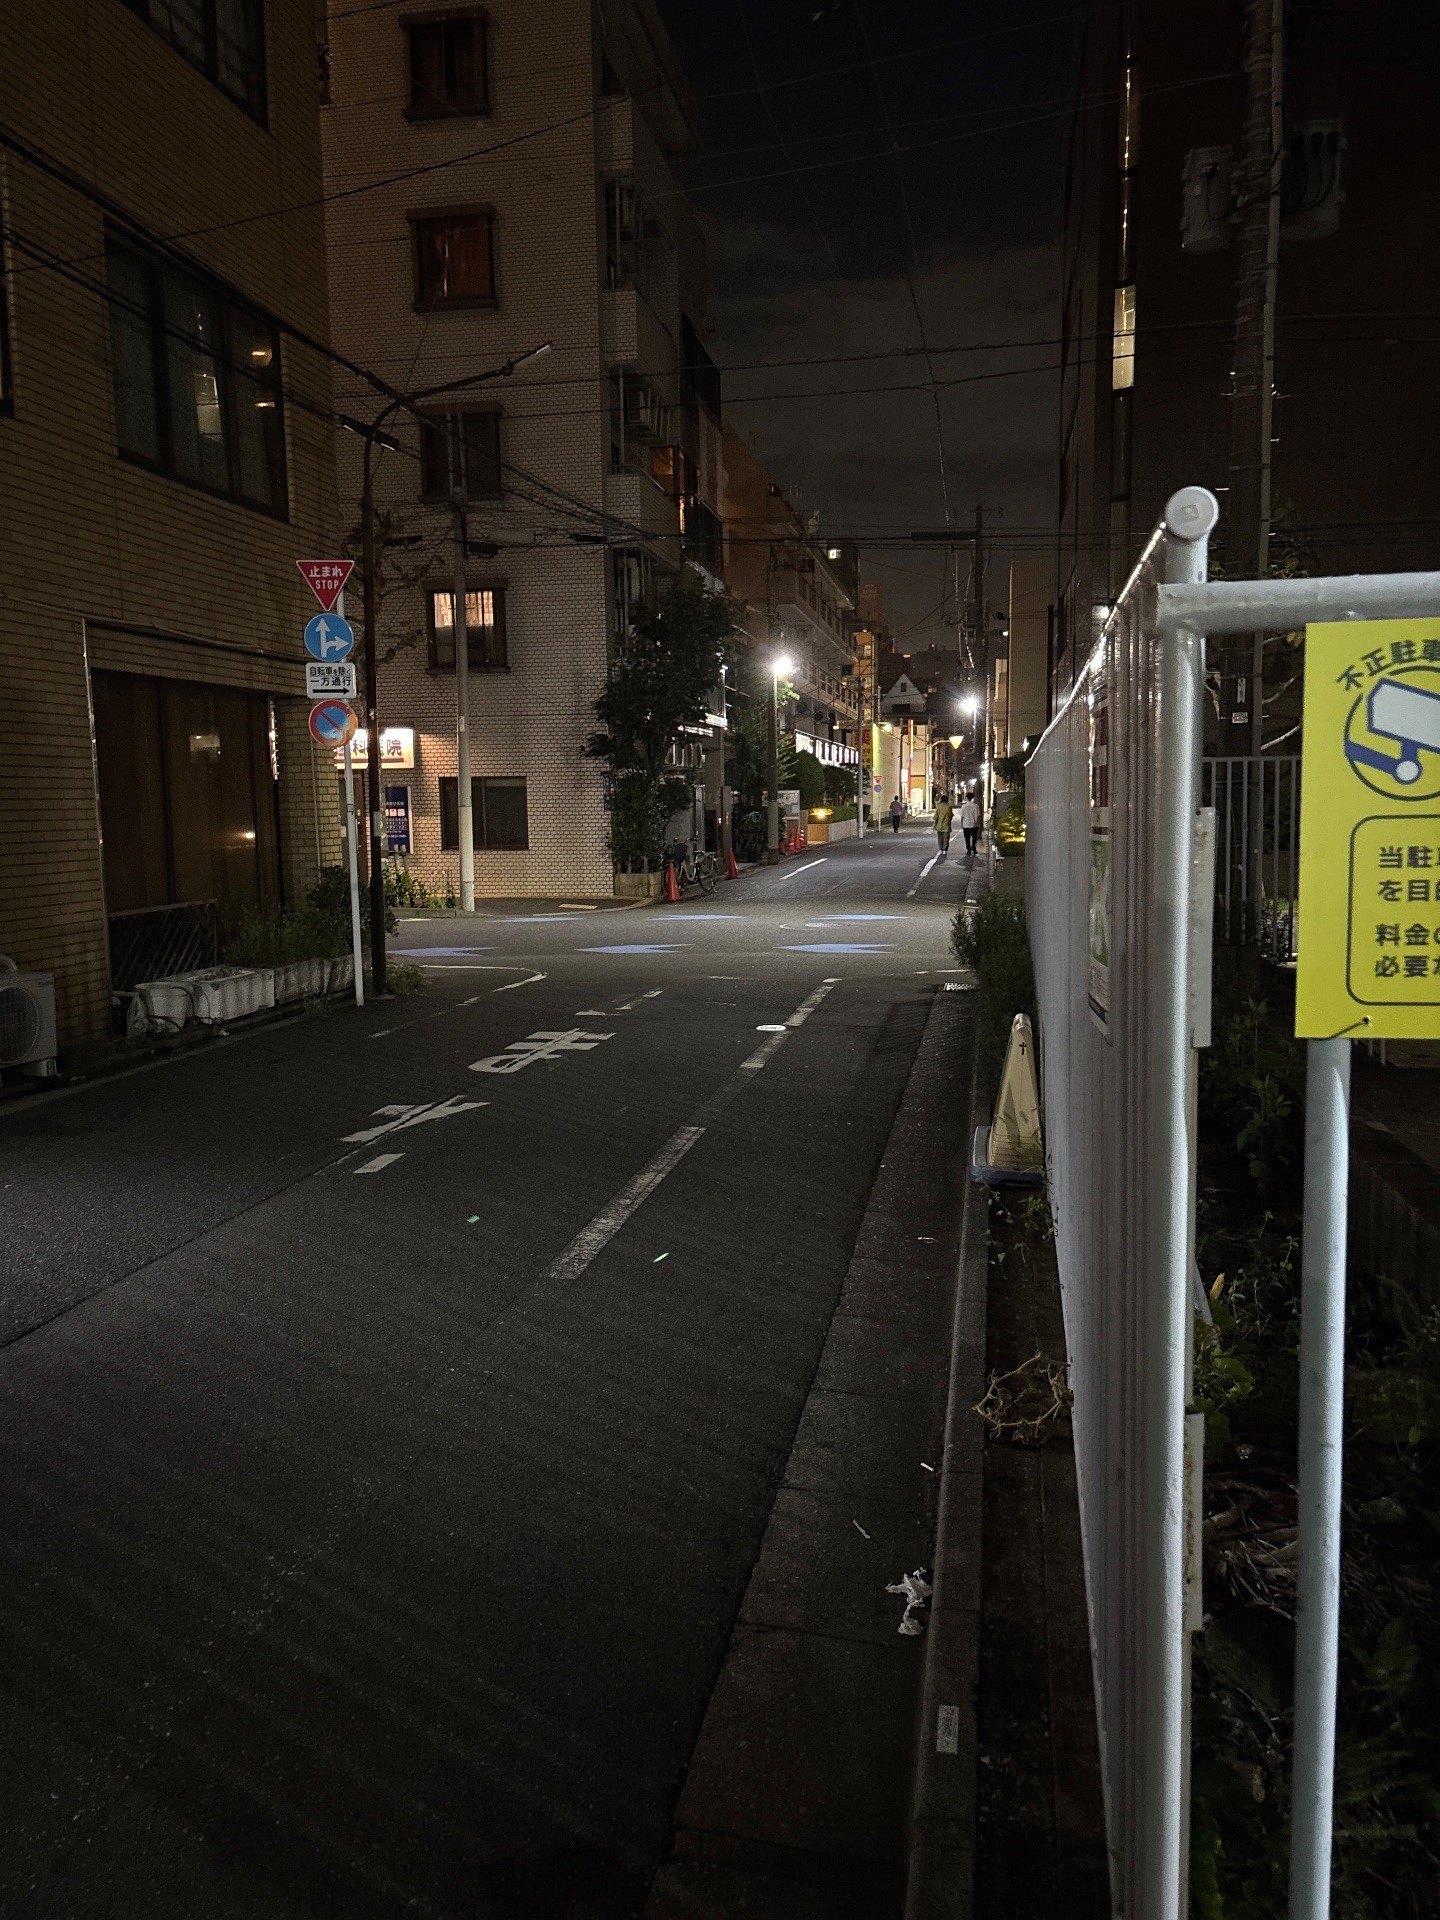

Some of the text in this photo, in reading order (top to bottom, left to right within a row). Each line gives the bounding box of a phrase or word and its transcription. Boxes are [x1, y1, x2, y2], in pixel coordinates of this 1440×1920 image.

[309, 565, 344, 578] 止まれ
[315, 580, 339, 590] STOP
[310, 666, 351, 676] 自転車を除く
[310, 676, 352, 687] 一方通行
[1379, 846, 1440, 868] 当駐
[1377, 880, 1440, 902] を目
